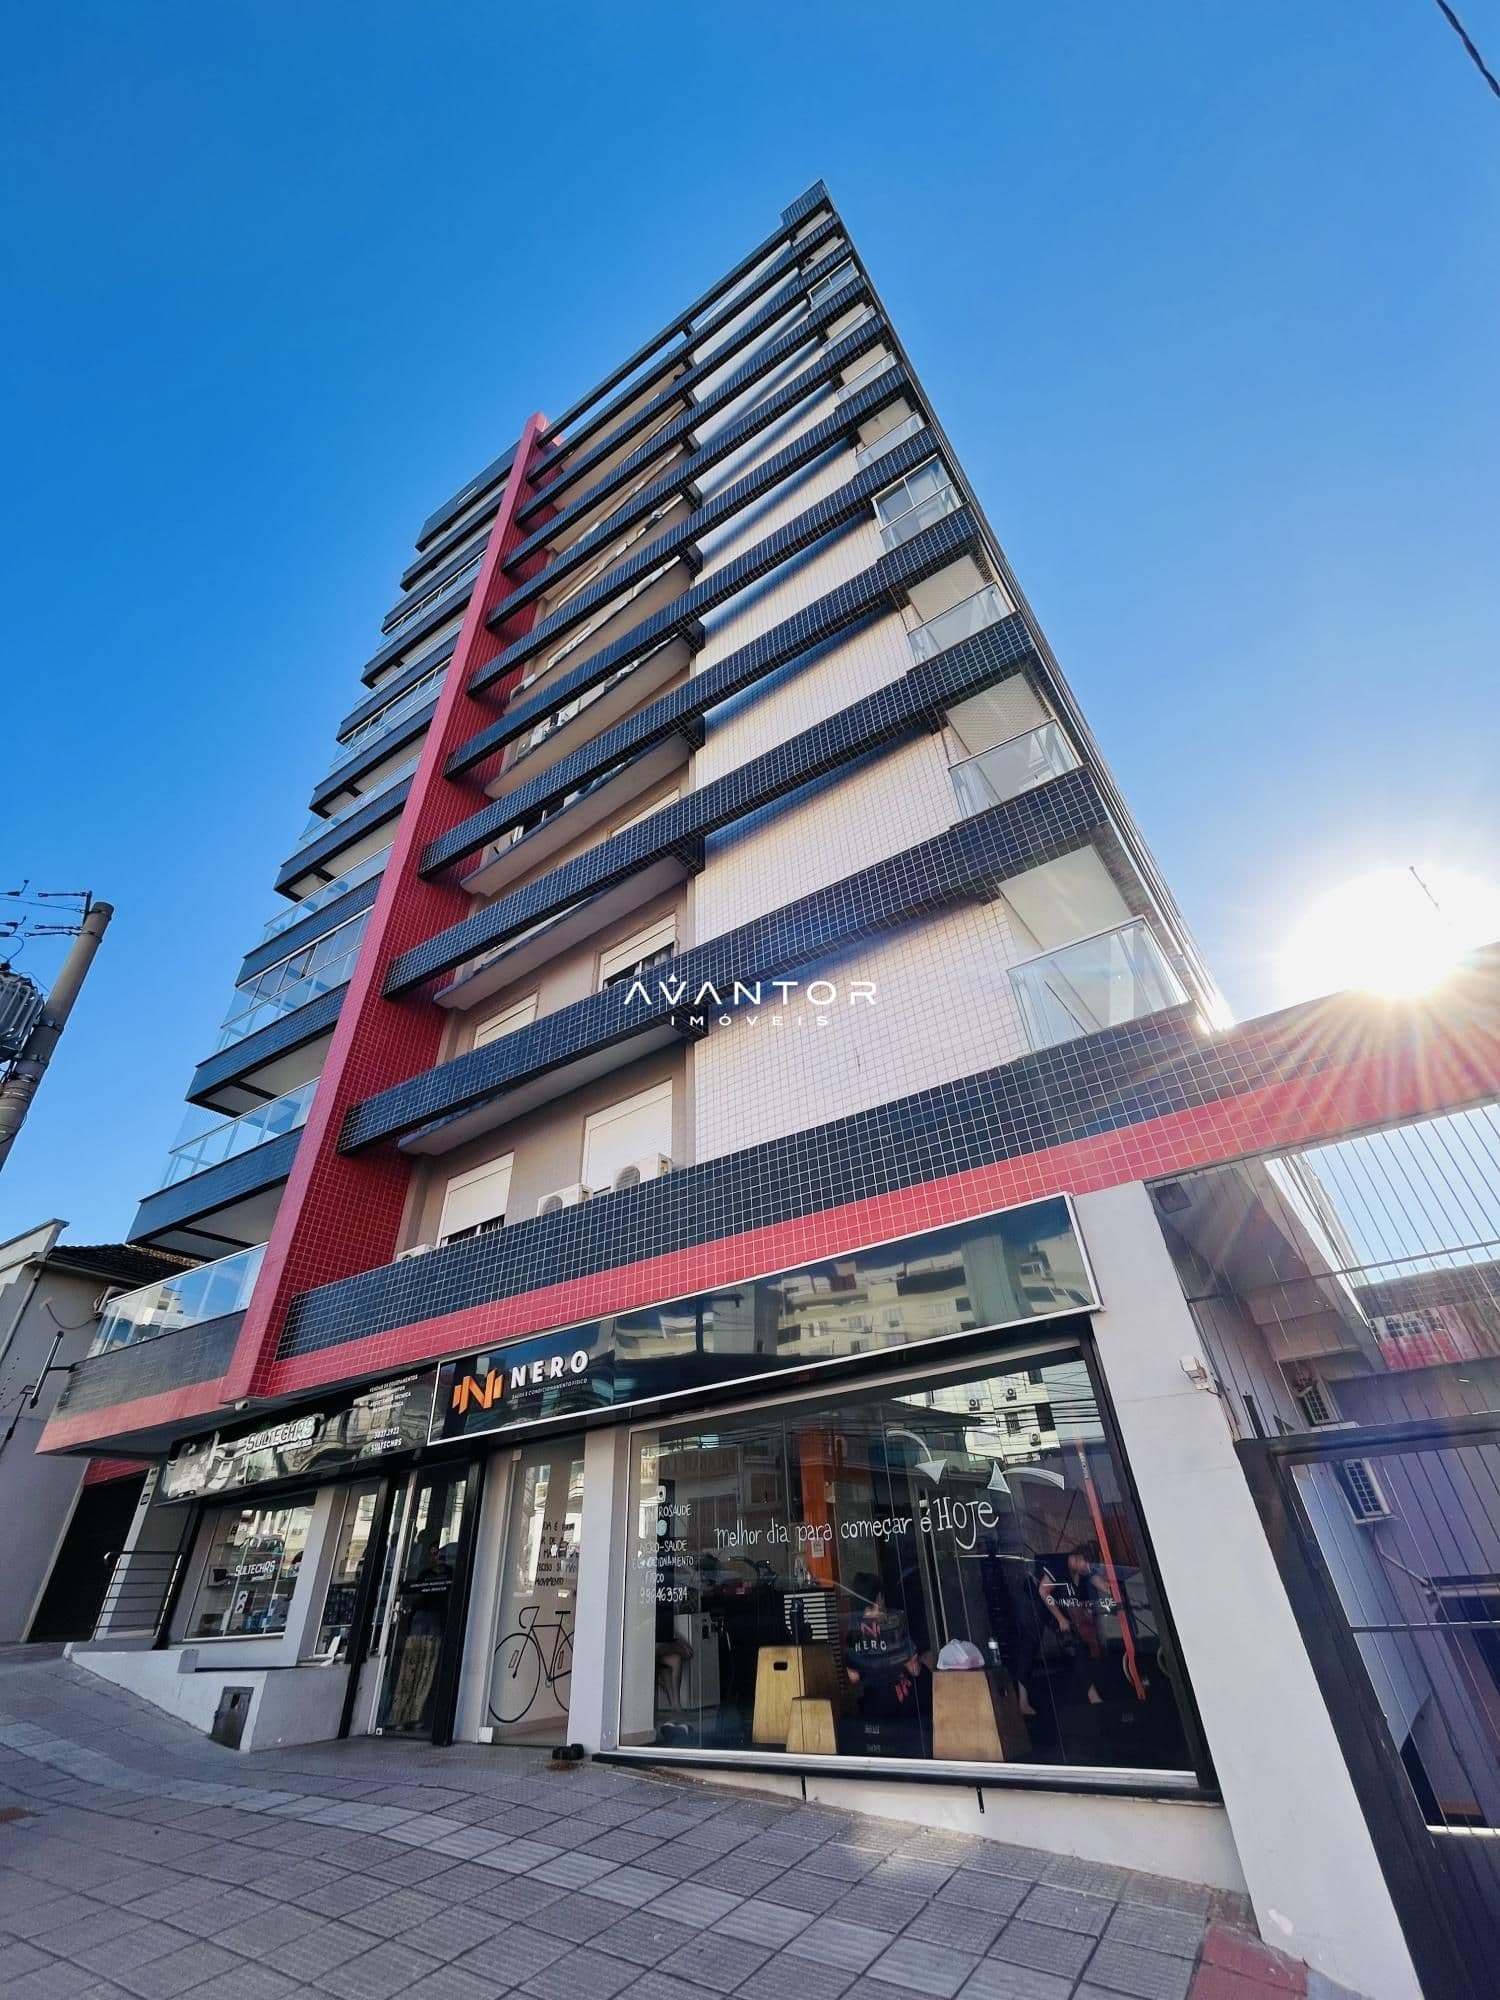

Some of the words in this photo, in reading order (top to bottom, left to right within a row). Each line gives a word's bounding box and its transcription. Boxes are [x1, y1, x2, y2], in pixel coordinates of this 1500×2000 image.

[510, 1350, 589, 1389] NERO
[714, 1520, 763, 1551] melhor
[767, 1517, 790, 1544] dia
[796, 1522, 834, 1551] para
[841, 1517, 913, 1543] começar
[235, 1560, 276, 1577] SULTECHRS
